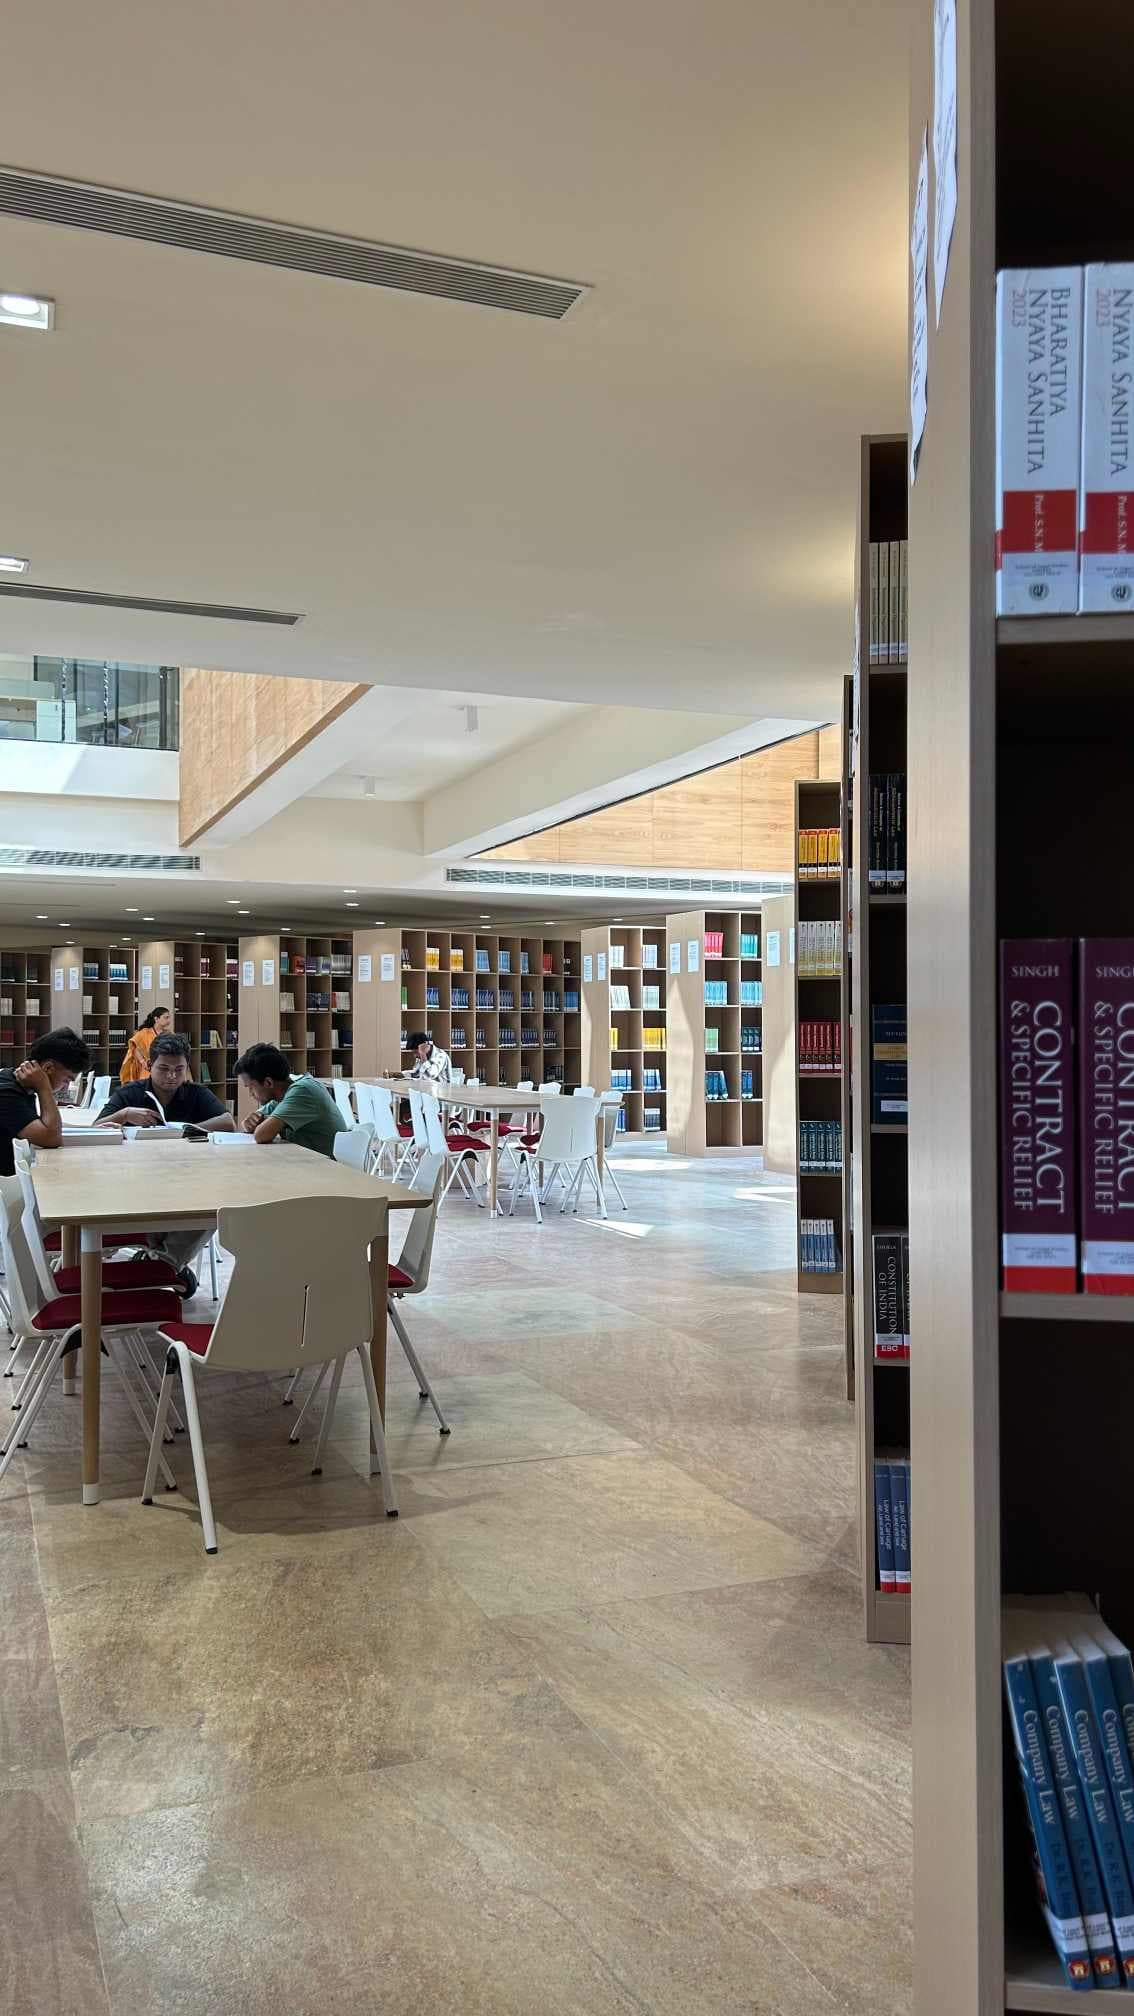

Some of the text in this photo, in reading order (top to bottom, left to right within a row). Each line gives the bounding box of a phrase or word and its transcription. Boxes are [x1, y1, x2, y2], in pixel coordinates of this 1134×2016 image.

[1011, 288, 1027, 328] 2023
[1049, 287, 1071, 417] BHARATIYA
[1095, 288, 1112, 328] 2023
[1027, 289, 1049, 474] NYAYA SANHITA
[1110, 289, 1133, 477] NYAYA SANHITA
[1034, 495, 1045, 515] Prof.
[1034, 519, 1045, 538] S.N.
[1117, 495, 1128, 516] Prof.
[1011, 965, 1060, 977] SINGH
[1095, 966, 1134, 978] SING
[1011, 1001, 1034, 1212] & SPECIFIC RELIEF
[1033, 1001, 1065, 1214] CONTRACT
[1094, 1001, 1115, 1215] & SPECIFIC RELIEF
[878, 1272, 888, 1321] OF INDIA
[887, 1256, 898, 1337] CONSTITUTION
[1024, 1709, 1055, 1824] Company Law
[1046, 1705, 1079, 1820] Company Law
[1075, 1709, 1107, 1823] Company Law
[1103, 1708, 1134, 1824] Company Law
